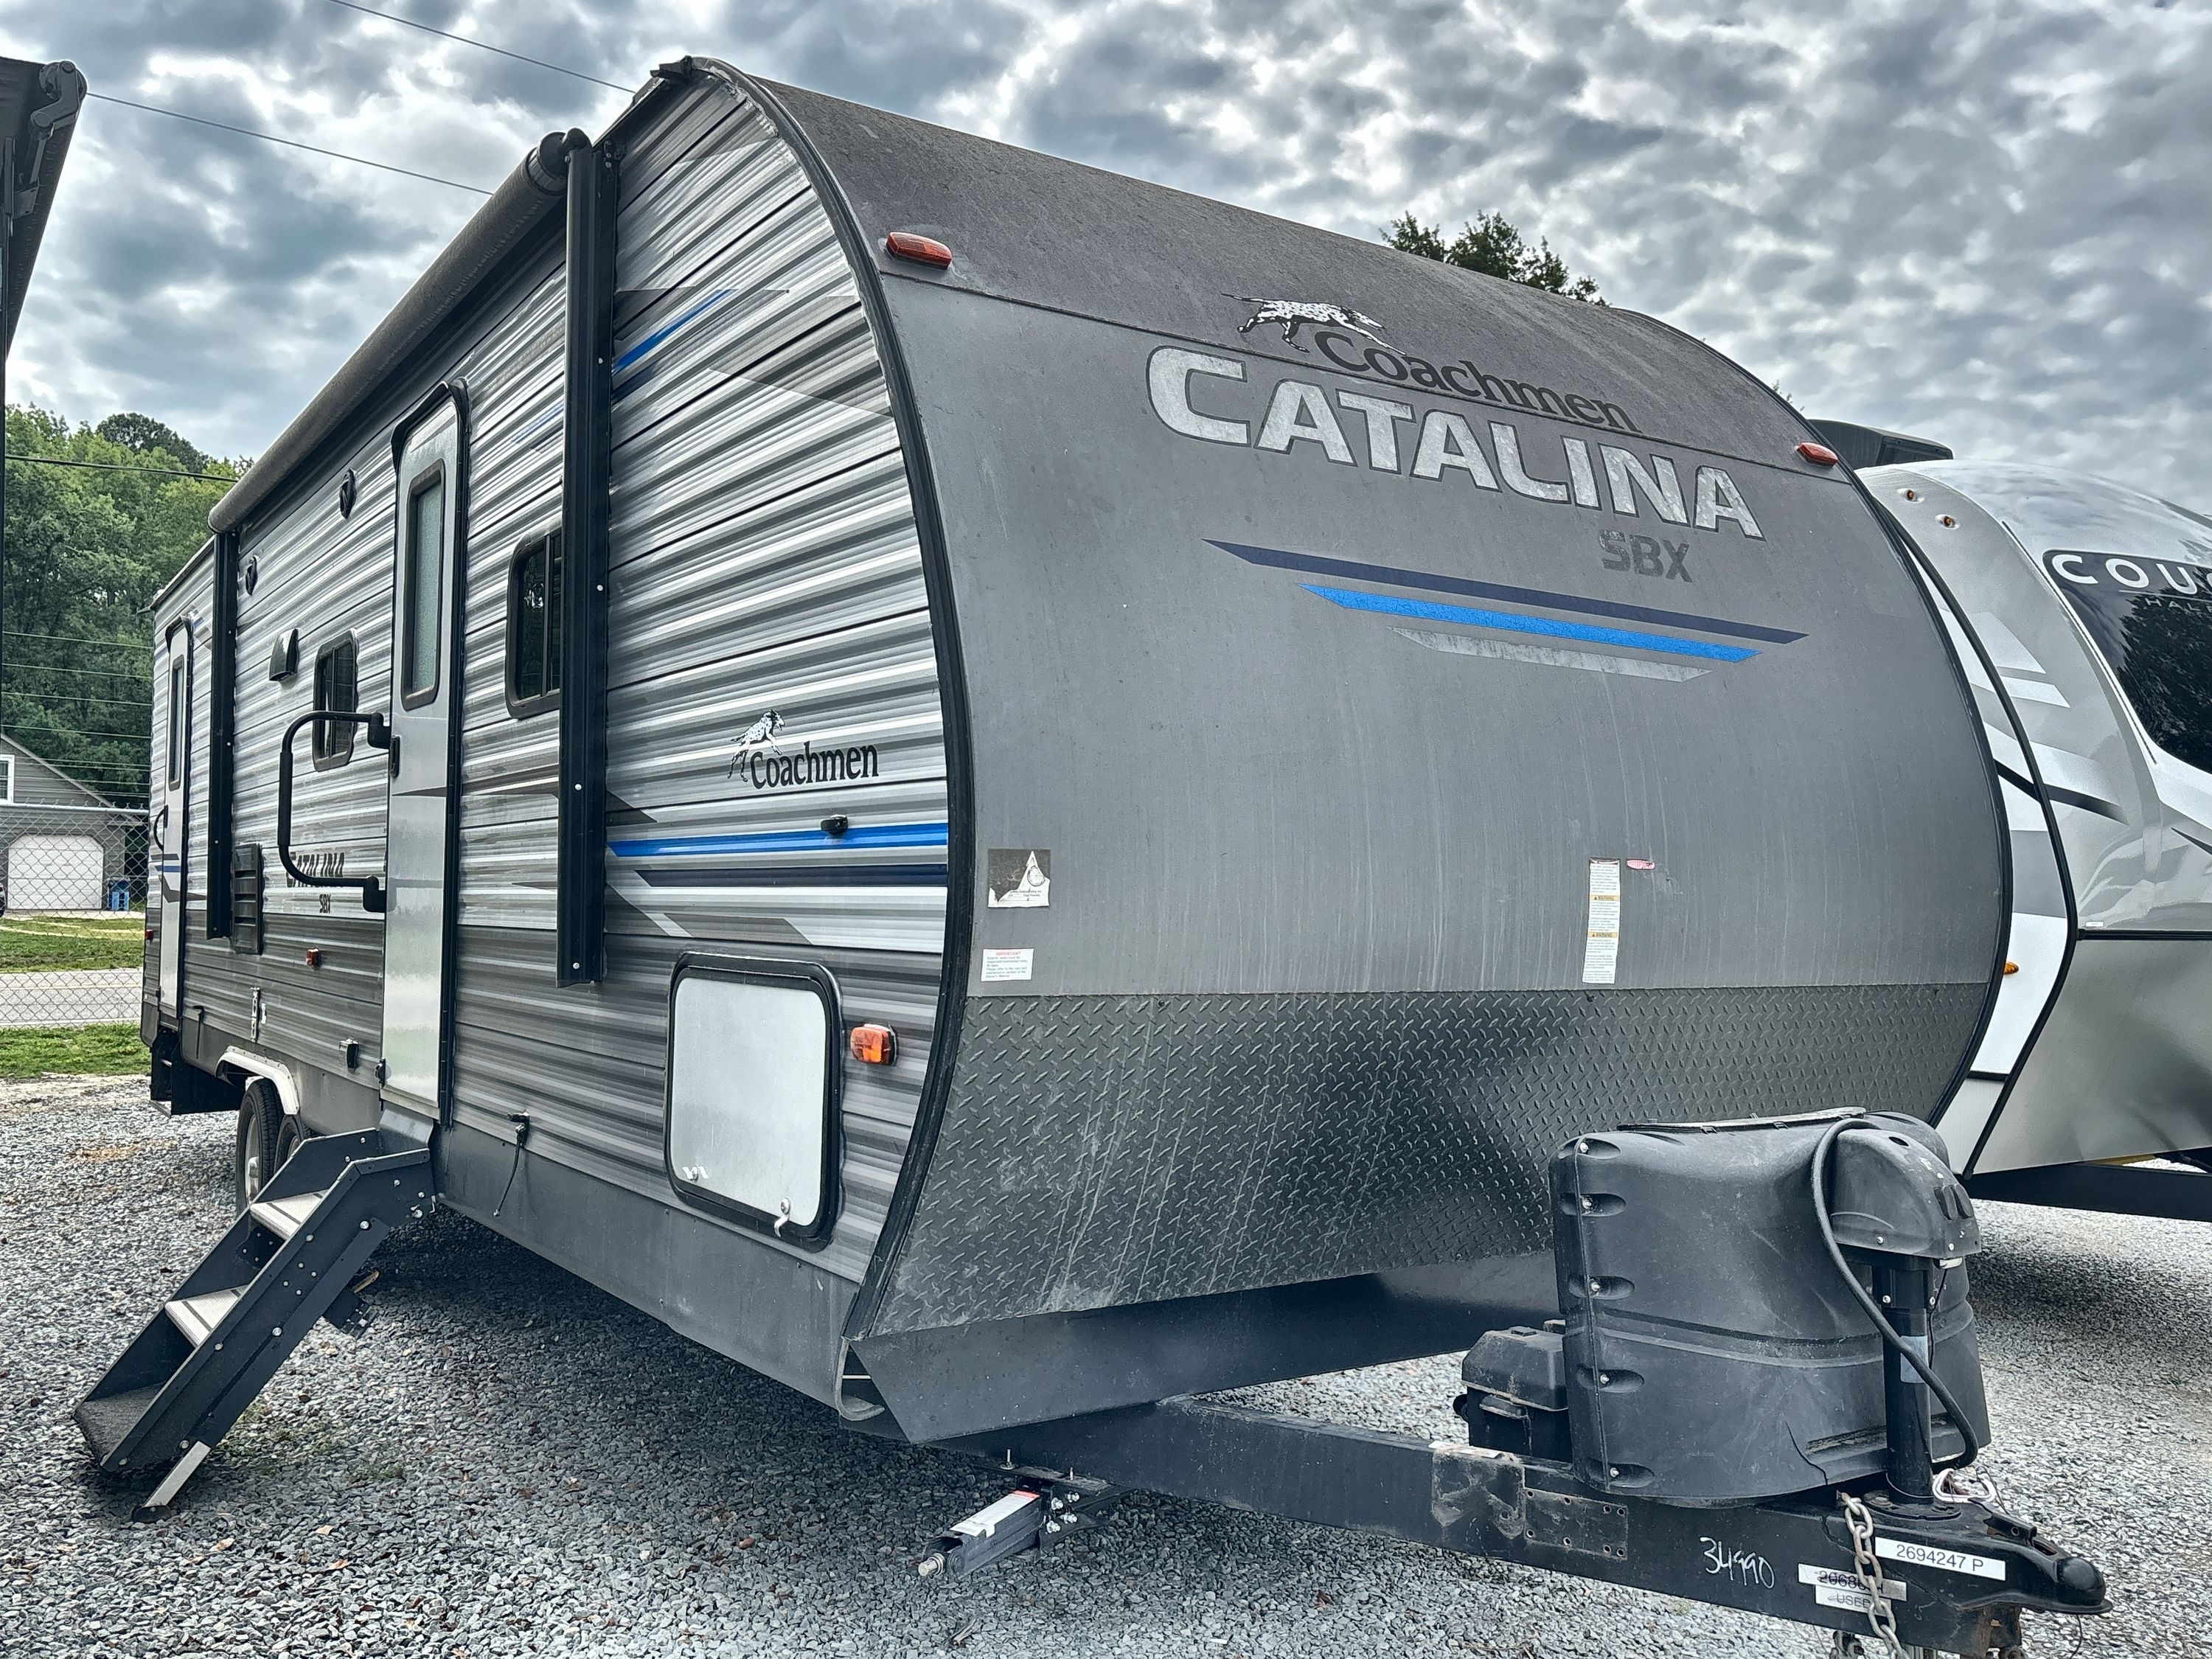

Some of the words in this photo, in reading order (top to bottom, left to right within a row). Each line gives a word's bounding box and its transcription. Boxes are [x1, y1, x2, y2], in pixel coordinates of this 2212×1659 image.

[1314, 330, 1643, 434] Coachmen
[1146, 345, 1767, 541] CATALINA
[1598, 528, 1693, 583] SBX
[750, 740, 879, 789] Coachmen
[1700, 1537, 1775, 1588] 34990
[1896, 1544, 1966, 1569] 2694247
[1972, 1558, 1984, 1571] P
